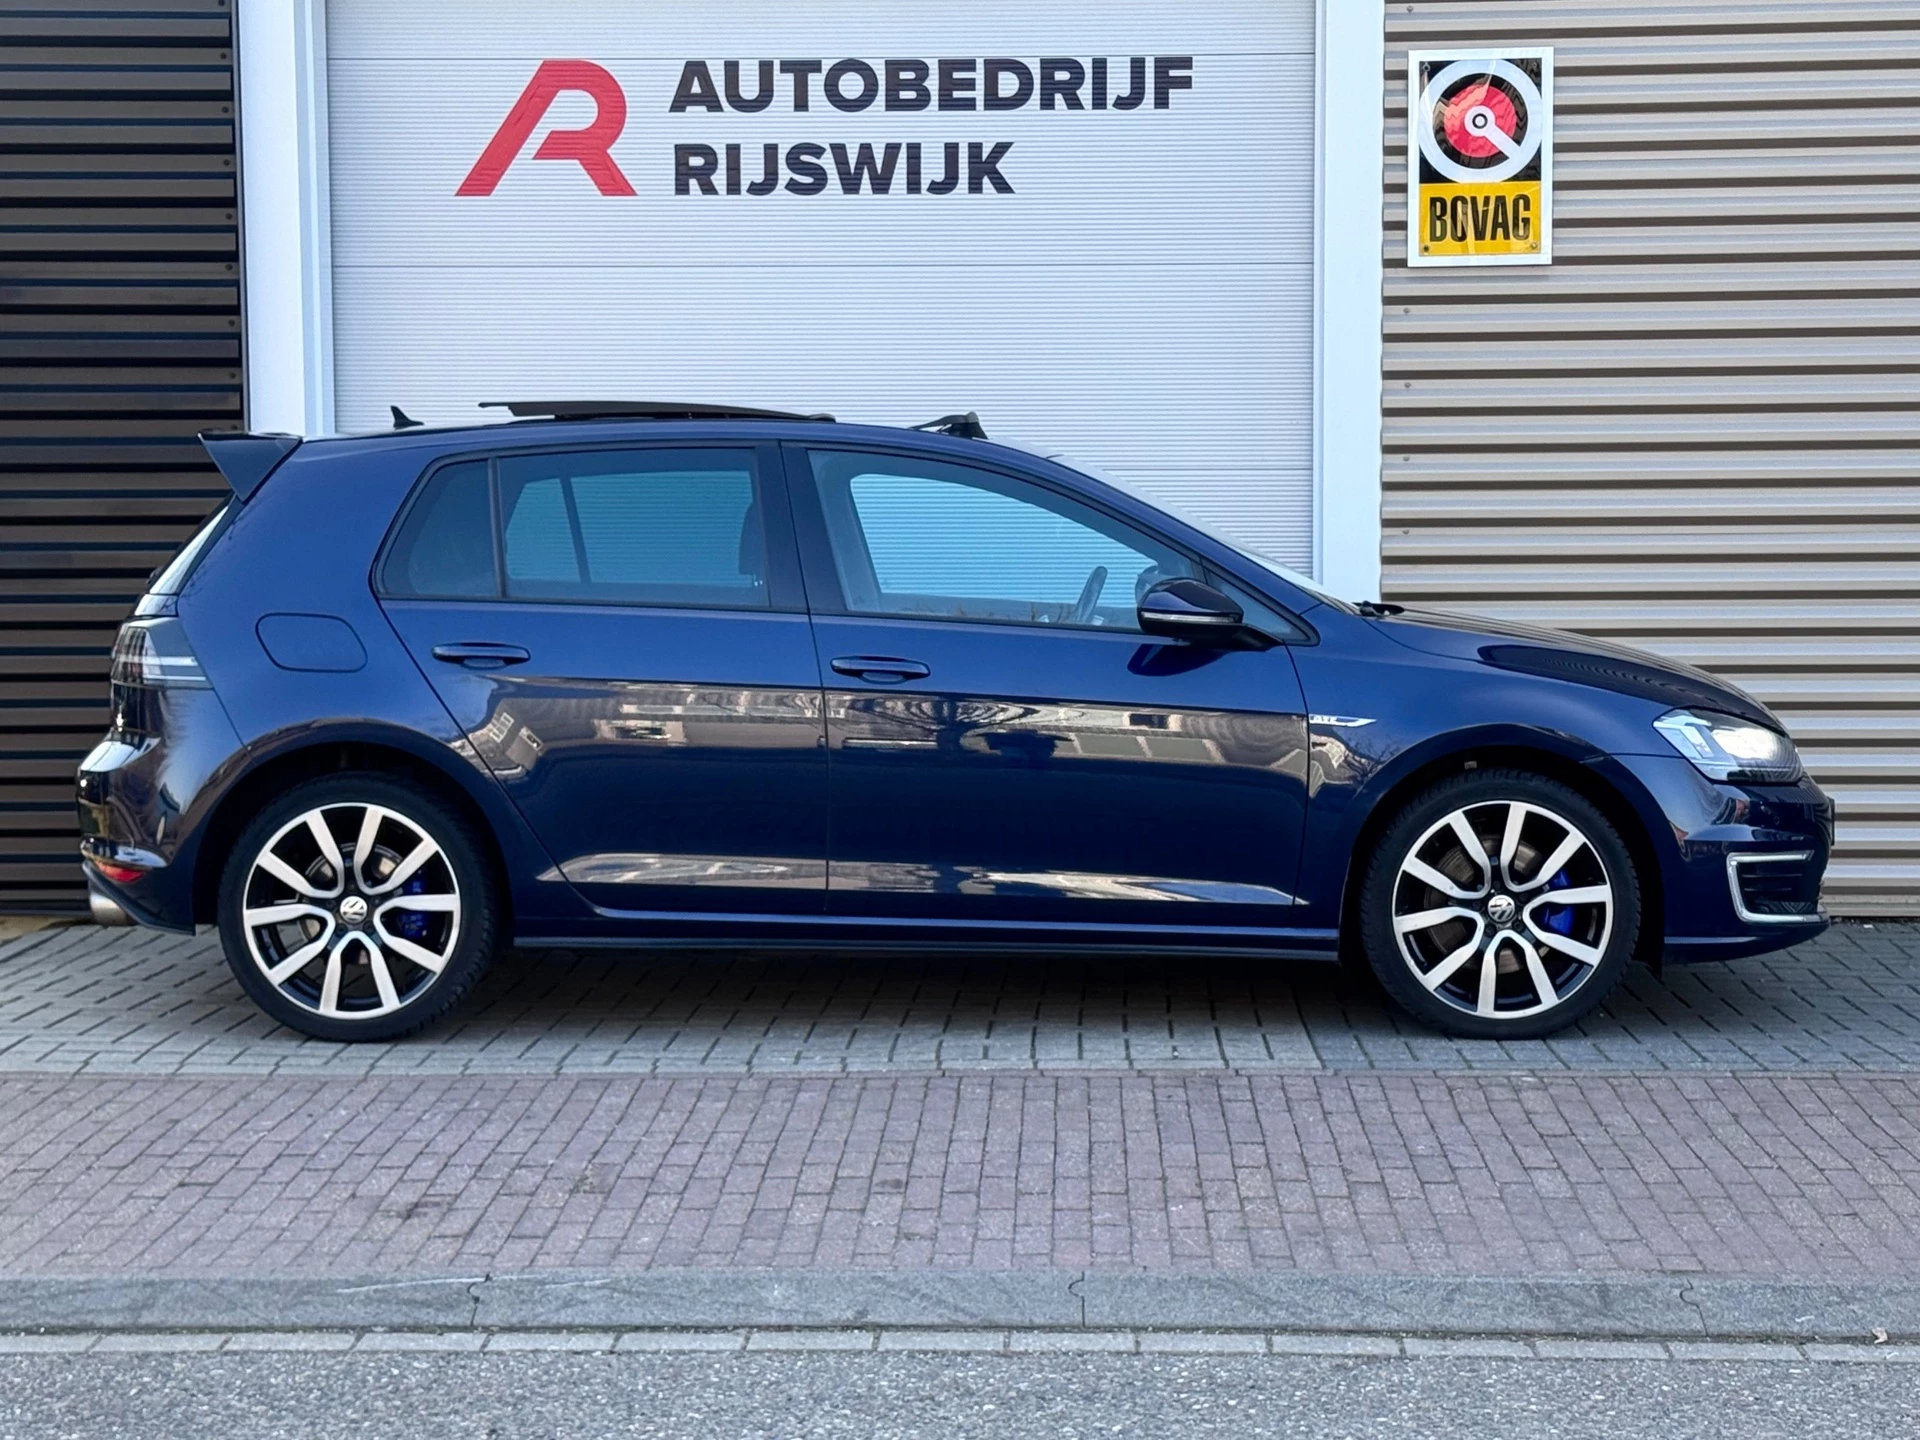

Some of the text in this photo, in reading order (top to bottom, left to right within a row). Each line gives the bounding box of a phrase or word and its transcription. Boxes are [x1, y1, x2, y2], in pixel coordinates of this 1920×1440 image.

[669, 56, 1193, 113] AUTOBEDRIJF
[673, 141, 1015, 196] RIJSWIJK
[1428, 194, 1531, 242] BOVAG
